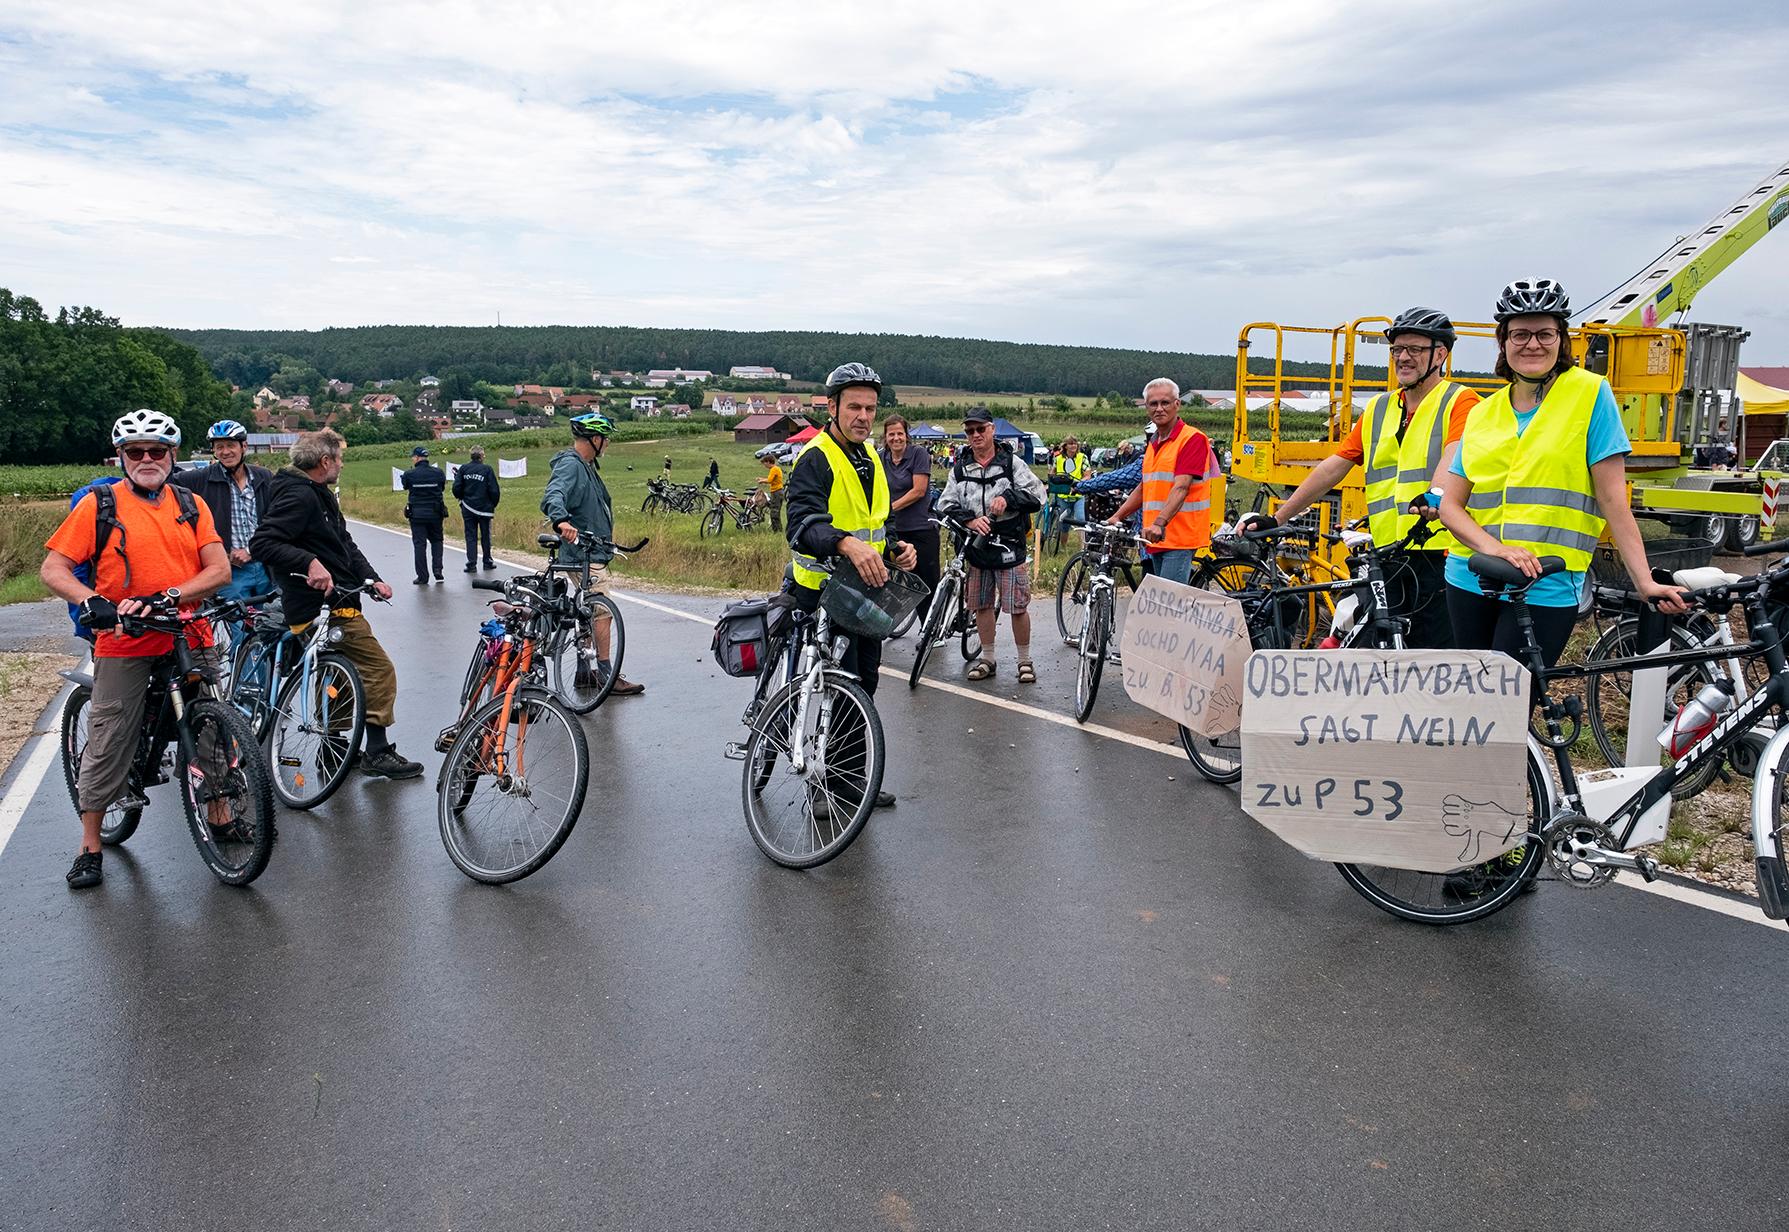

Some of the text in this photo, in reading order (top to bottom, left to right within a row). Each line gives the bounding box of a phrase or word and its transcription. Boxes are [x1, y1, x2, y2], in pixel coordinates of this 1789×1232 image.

[463, 474, 485, 482] POLIZEI
[1135, 627, 1179, 653] SOCHD
[1248, 654, 1522, 698] OBERMAINBACH
[1183, 685, 1205, 716] 53
[1294, 713, 1497, 746] SAGT NEIN
[1674, 686, 1768, 776] STEVENS
[1315, 777, 1337, 810] P
[1353, 779, 1404, 822] 53
